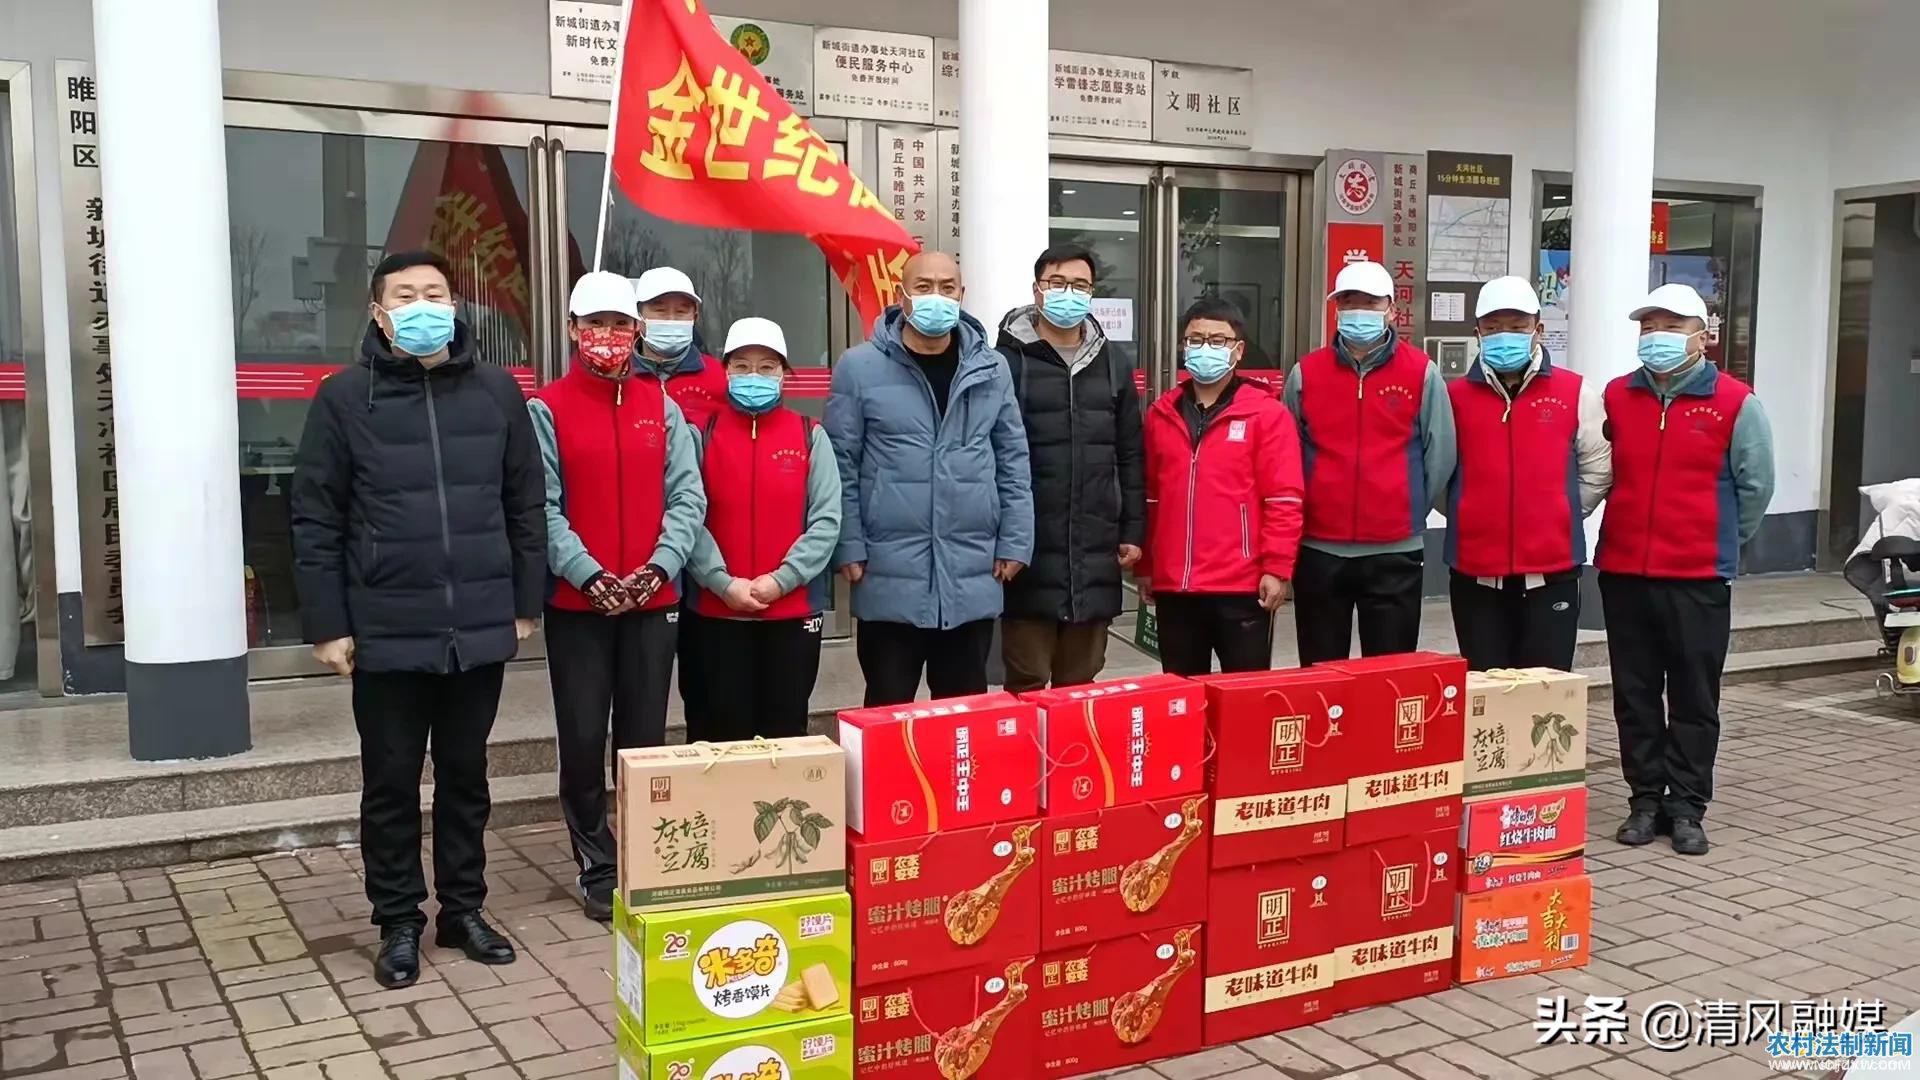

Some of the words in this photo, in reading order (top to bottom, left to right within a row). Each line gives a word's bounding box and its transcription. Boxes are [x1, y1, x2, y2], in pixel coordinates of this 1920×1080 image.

[822, 40, 926, 59] 新城街道办事处天河社区
[835, 54, 913, 74] 便民服务中心
[1055, 64, 1146, 79] 新城街道办事处天河社区
[1054, 77, 1147, 96] 学雷锋志愿服务站
[1166, 91, 1241, 116] 文明社区
[67, 76, 99, 168] 睢阳区
[893, 138, 905, 220] 商丘市睢阳区
[912, 139, 926, 221] 中国共产党
[1393, 164, 1403, 247] 新城街道办事处
[1408, 165, 1417, 247] 商丘市睢阳区
[1365, 770, 1449, 798] 老味道牛肉
[1235, 793, 1330, 820] 老味道牛肉
[1500, 827, 1556, 848] 红烧牛肉面
[1052, 866, 1117, 895] 蜜汁烤腿
[868, 896, 940, 925] 蜜汁烤腿
[1540, 888, 1568, 952] 大吉大利
[664, 933, 687, 953] 20
[1351, 935, 1438, 966] 老味道牛肉
[698, 934, 779, 989] 米多奇
[1225, 963, 1318, 997] 老味道牛肉
[713, 985, 771, 1007] 烤香馍片
[1042, 998, 1109, 1028] 蜜汁烤腿
[858, 1035, 931, 1065] 蜜汁烤腿
